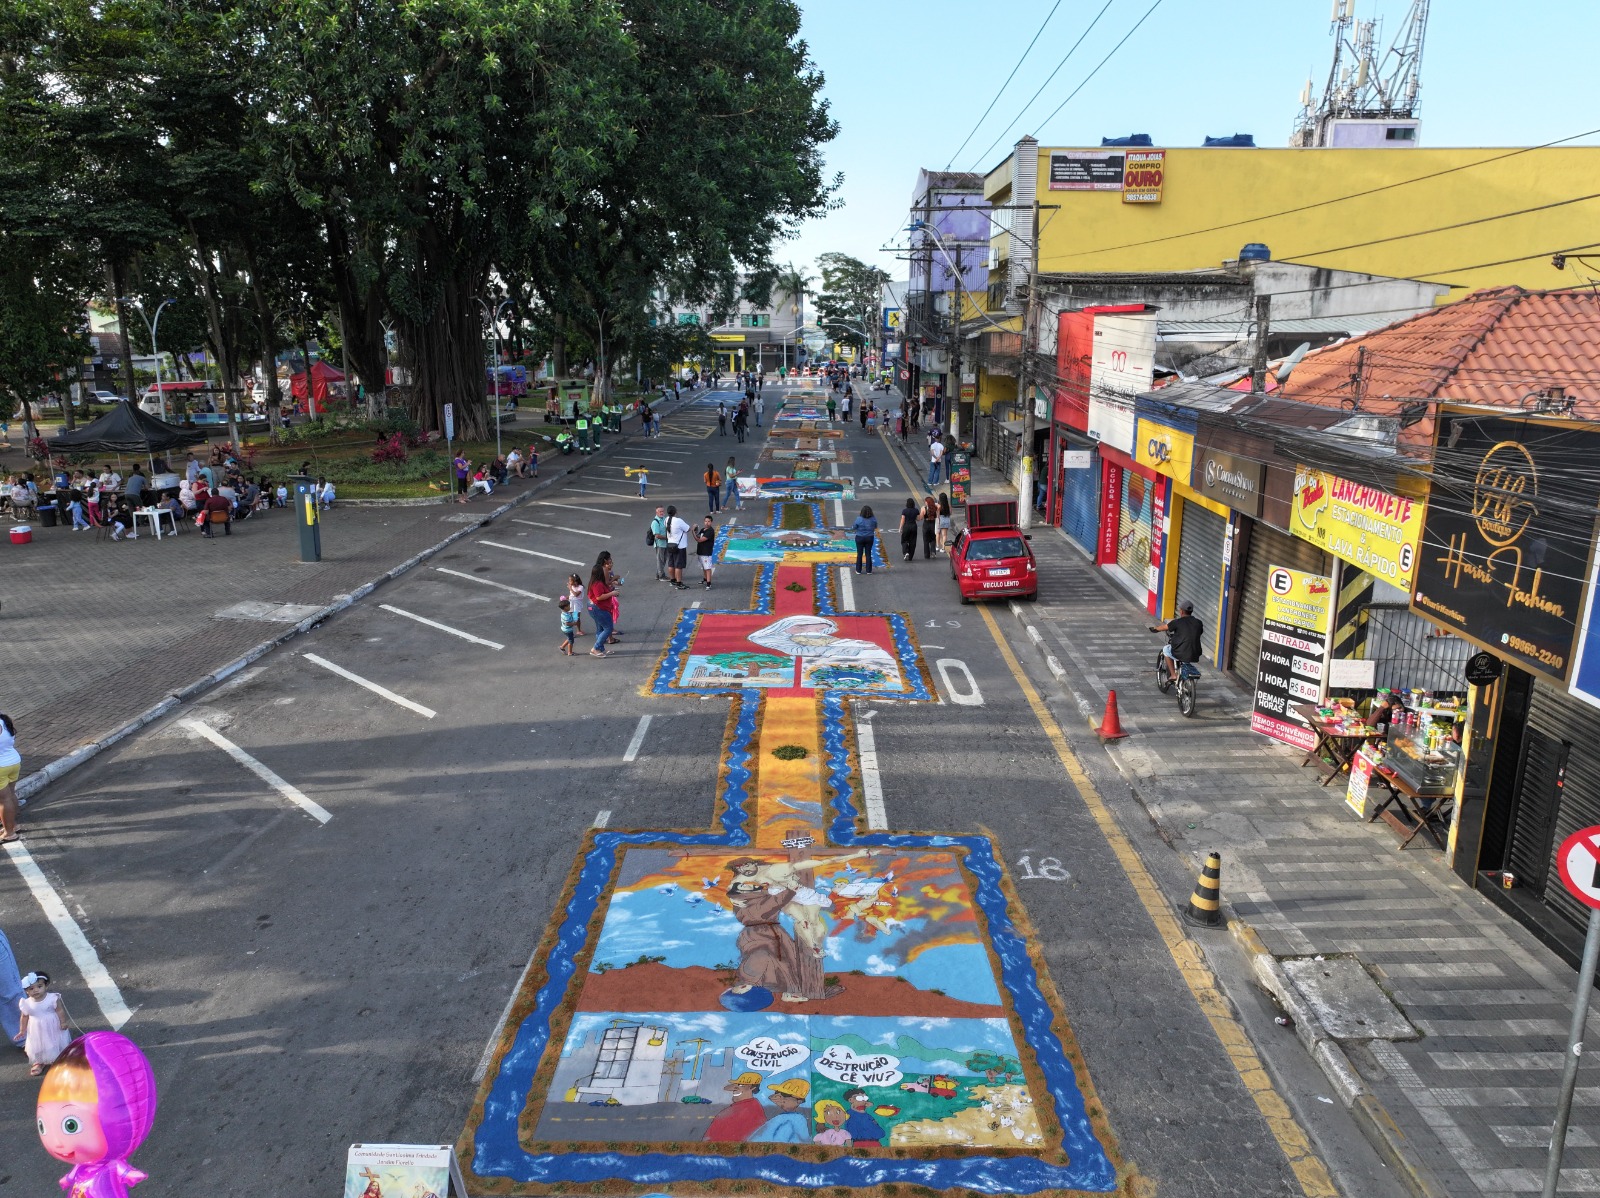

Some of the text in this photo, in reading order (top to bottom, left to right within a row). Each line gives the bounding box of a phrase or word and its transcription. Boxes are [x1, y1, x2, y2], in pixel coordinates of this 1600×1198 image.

[1125, 170, 1163, 187] OURO
[1148, 439, 1168, 462] CVC
[1331, 475, 1415, 524] LANCHONETE
[1331, 505, 1403, 544] ESTACIONAMENTO
[1481, 517, 1512, 538] Boutique
[1360, 533, 1366, 544] &
[1328, 534, 1353, 559] LAVA
[1355, 545, 1397, 578] RÁPIDO
[1402, 548, 1411, 568] E
[1274, 573, 1287, 591] E
[1436, 532, 1564, 618] Hariri Fashion
[1272, 595, 1325, 614] ESTACIONAMENTO
[1277, 606, 1317, 620] LANCHONETE
[1277, 613, 1292, 622] LAVA
[1268, 632, 1311, 651] ENTRADA
[1509, 634, 1563, 670] 99869-2240
[1261, 651, 1320, 674] 1/2 HORA R$ 5,00
[1264, 673, 1288, 690] HORA
[1289, 682, 1299, 693] R$
[1300, 686, 1317, 698] 8,00
[1257, 690, 1285, 707] DEMAIS
[1258, 698, 1283, 713] HORAS
[1253, 715, 1275, 728] TEMOS
[1276, 723, 1314, 742] CONVÊNIOS
[1017, 855, 1071, 880] 18
[740, 1046, 799, 1060] CONSTRUÇÃO
[767, 1043, 774, 1051] A
[829, 1047, 852, 1060] É A
[751, 1058, 782, 1068] CIVIL
[819, 1056, 889, 1073] DESTRUIÇÃO
[840, 1070, 896, 1084] CÊ VIU?
